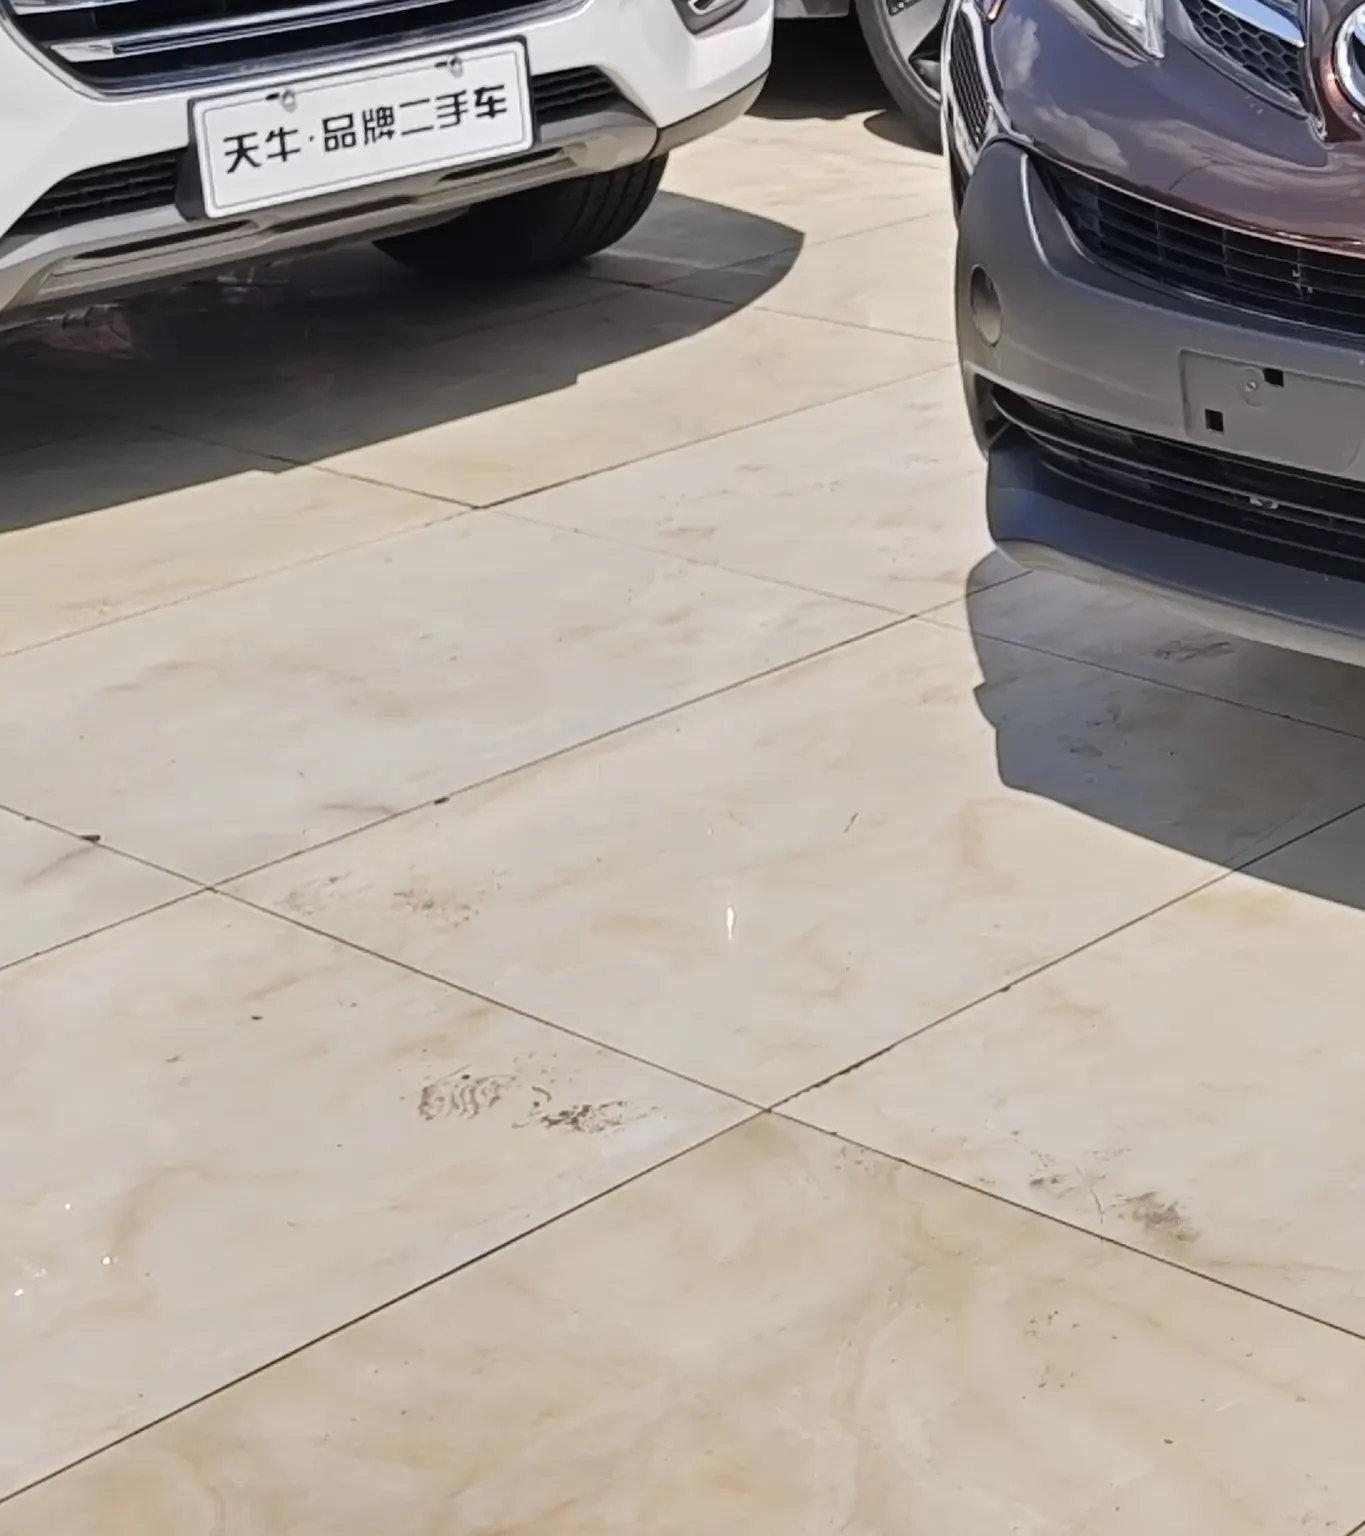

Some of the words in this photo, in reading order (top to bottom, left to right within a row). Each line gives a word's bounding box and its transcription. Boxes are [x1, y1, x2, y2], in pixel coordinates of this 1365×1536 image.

[223, 83, 508, 175] 天牛·品牌二手车
